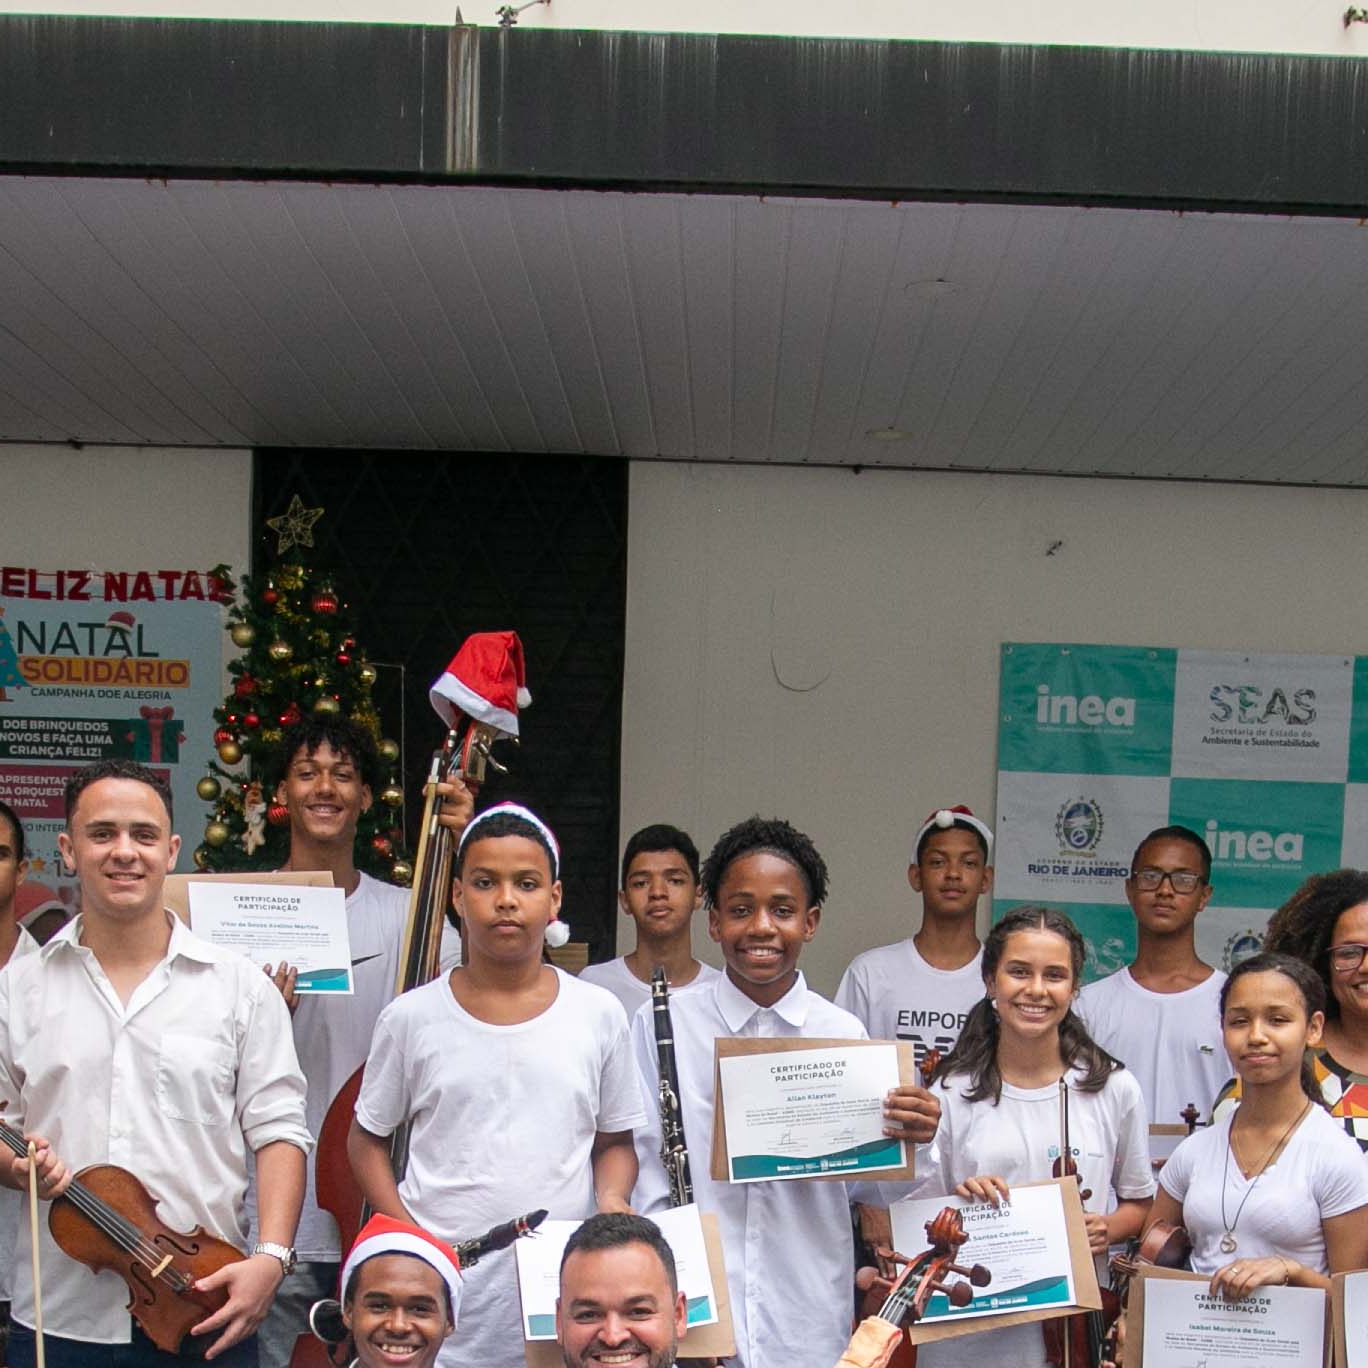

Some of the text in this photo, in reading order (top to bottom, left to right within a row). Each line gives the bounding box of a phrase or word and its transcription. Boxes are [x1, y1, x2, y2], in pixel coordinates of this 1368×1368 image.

[17, 620, 159, 657] NATAL
[22, 655, 188, 684] SOLIDÁRIO
[31, 688, 172, 700] CAMPANHA DOE ALEGRIA
[1037, 684, 1136, 726] inea
[1209, 684, 1317, 725] SEAS
[3, 719, 109, 732] DOE BRINQUEDOS
[1210, 727, 1252, 736] Secretaria
[1270, 729, 1299, 737] Estado
[43, 734, 50, 743] E
[52, 733, 83, 745] FAÇA
[85, 734, 113, 744] UMA
[1202, 736, 1242, 745] Ambiente
[1252, 738, 1320, 748] Sustentabilidade
[9, 746, 102, 757] CRIANÇA FELIZ!
[14, 788, 65, 797] ORQUEST
[14, 799, 48, 807] NATAL
[36, 824, 64, 832] INTER
[1205, 820, 1304, 861] inea
[1028, 864, 1128, 877] RIO DE JANEIRO
[233, 895, 289, 903] CERTIFICADO
[238, 904, 298, 912] PARTICIPAÇÃO
[897, 1010, 969, 1029] EMPOR
[770, 1062, 832, 1074] CERTIFICADO
[775, 1069, 843, 1082] PARTICIPAÇÃO
[962, 1211, 1010, 1222] TICIPAÇÃO
[1199, 1303, 1267, 1314] PARTICIPAÇÃO
